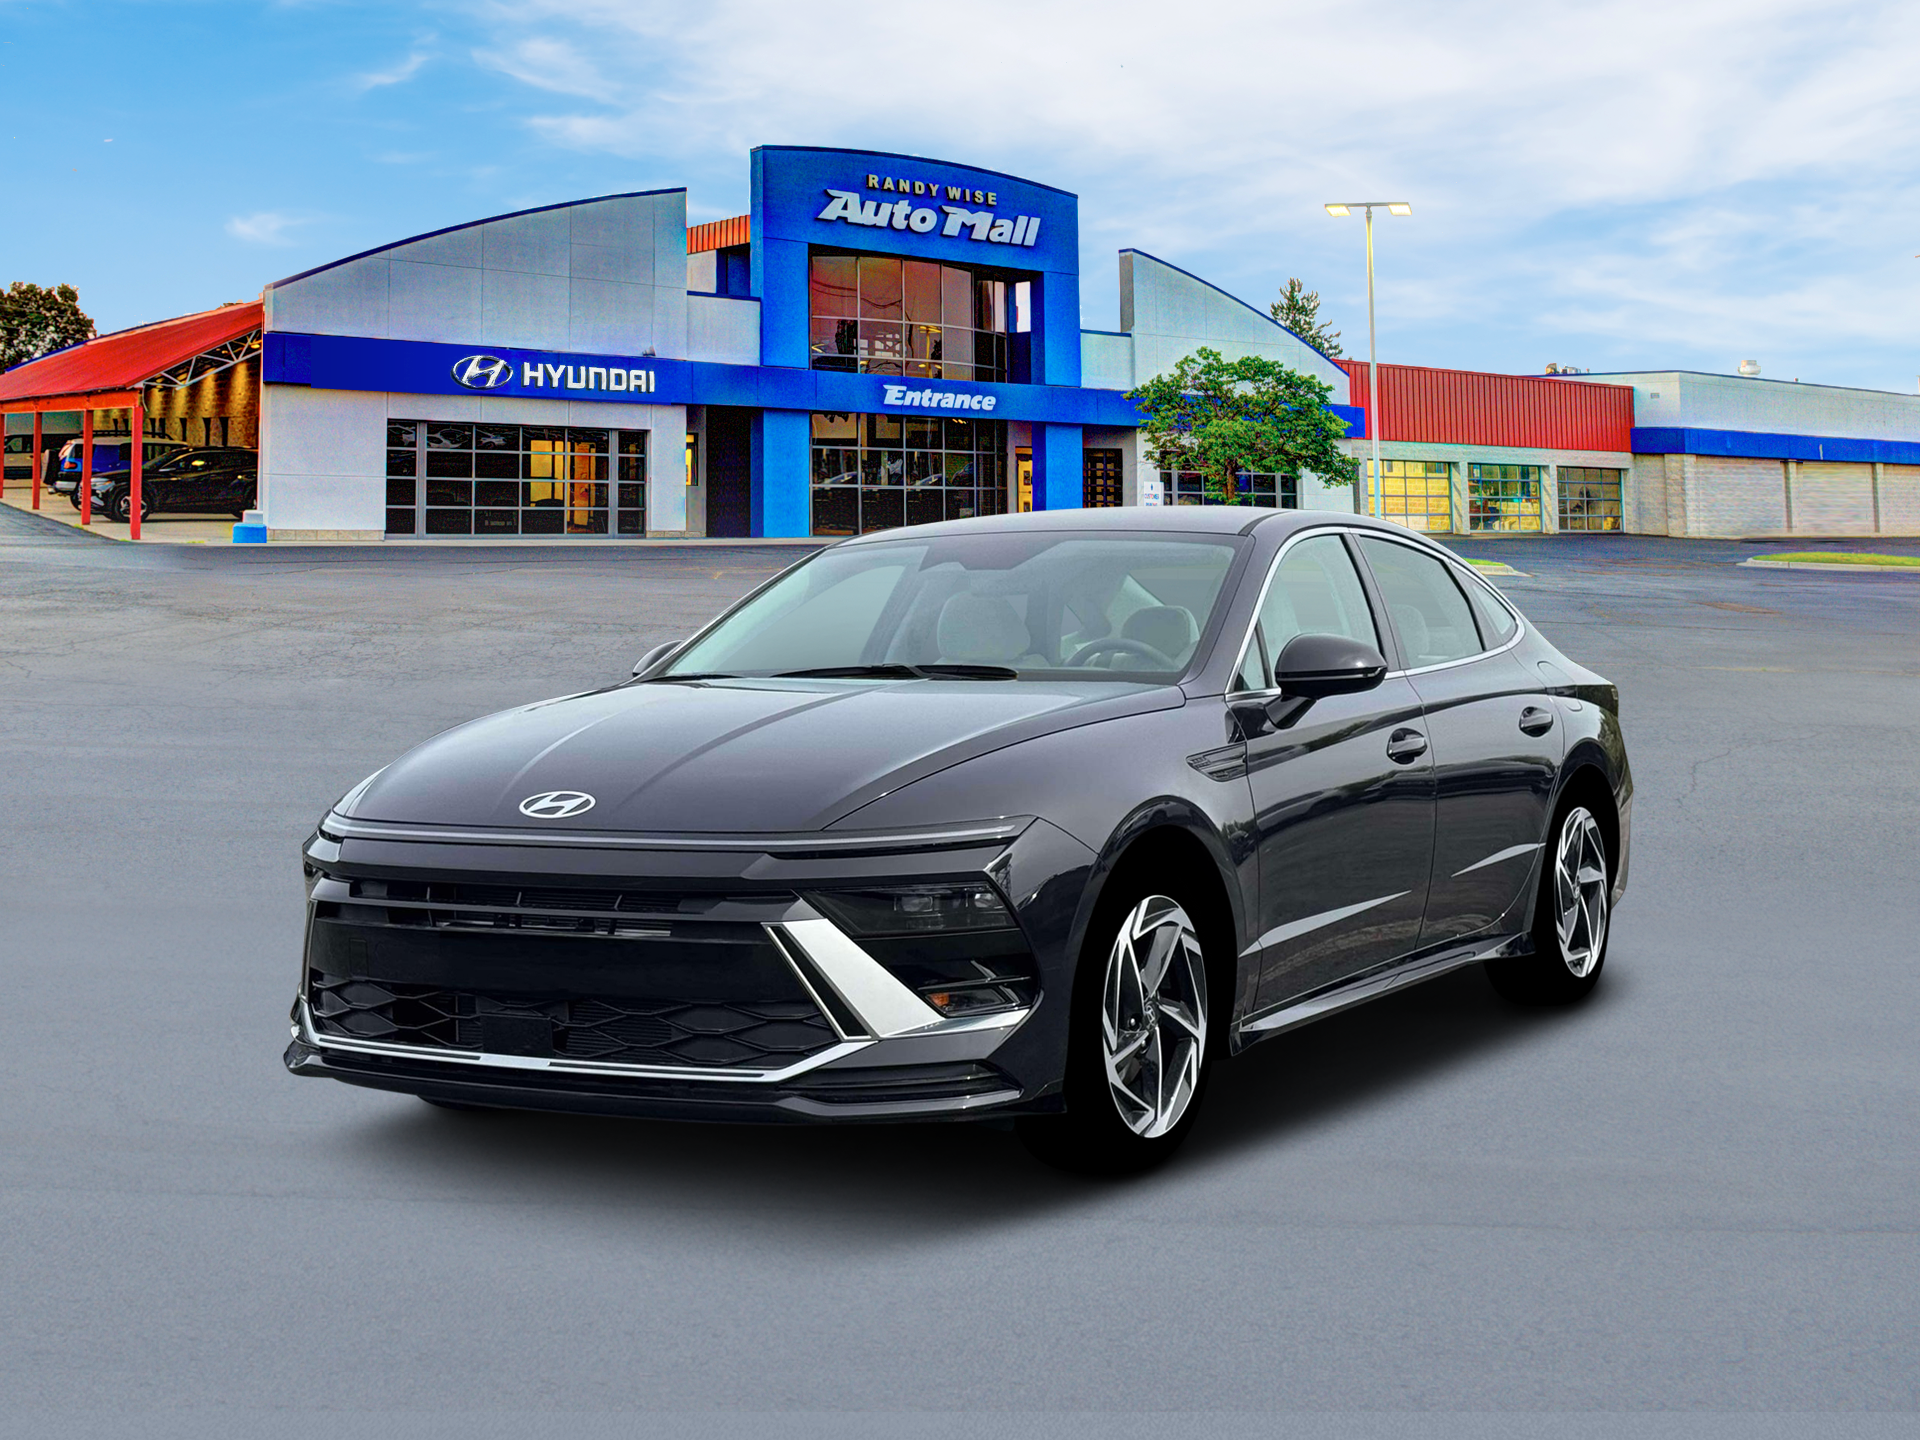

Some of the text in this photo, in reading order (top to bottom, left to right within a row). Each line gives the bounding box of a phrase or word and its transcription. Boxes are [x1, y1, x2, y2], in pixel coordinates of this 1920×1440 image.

[867, 174, 998, 205] RANDY WISE
[817, 189, 1041, 246] Auto Mall
[522, 361, 655, 393] HYUNDAI
[882, 384, 997, 411] Entrance
